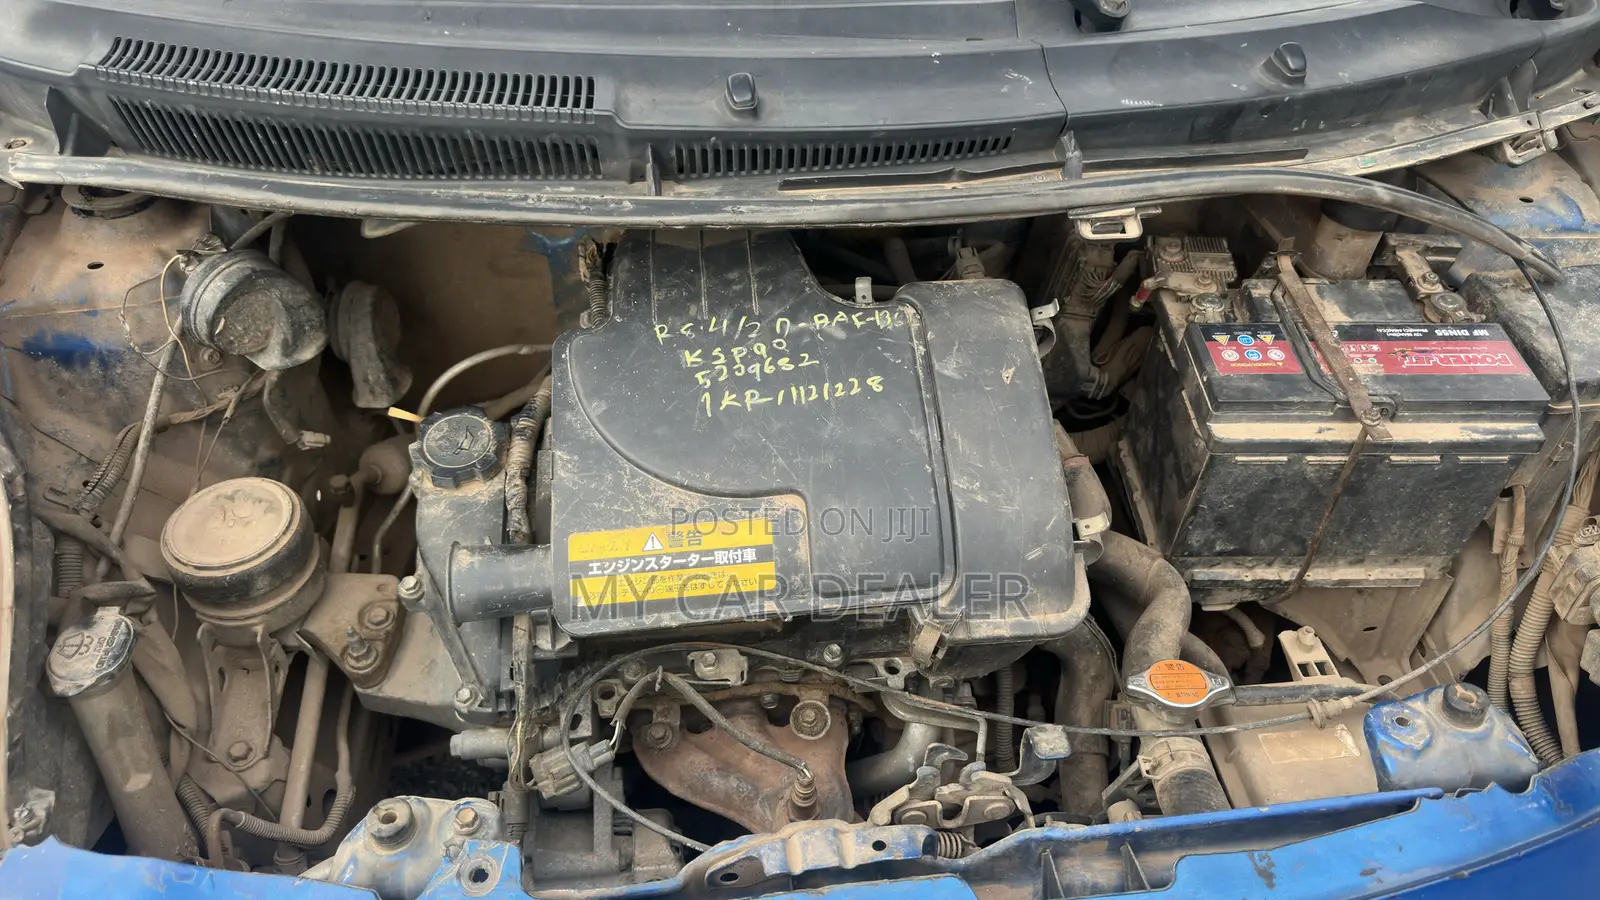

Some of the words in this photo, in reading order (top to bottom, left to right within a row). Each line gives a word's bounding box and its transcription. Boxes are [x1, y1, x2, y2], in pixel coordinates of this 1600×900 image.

[667, 529, 703, 548] 警告
[588, 547, 758, 575] エンジンスターター取付車
